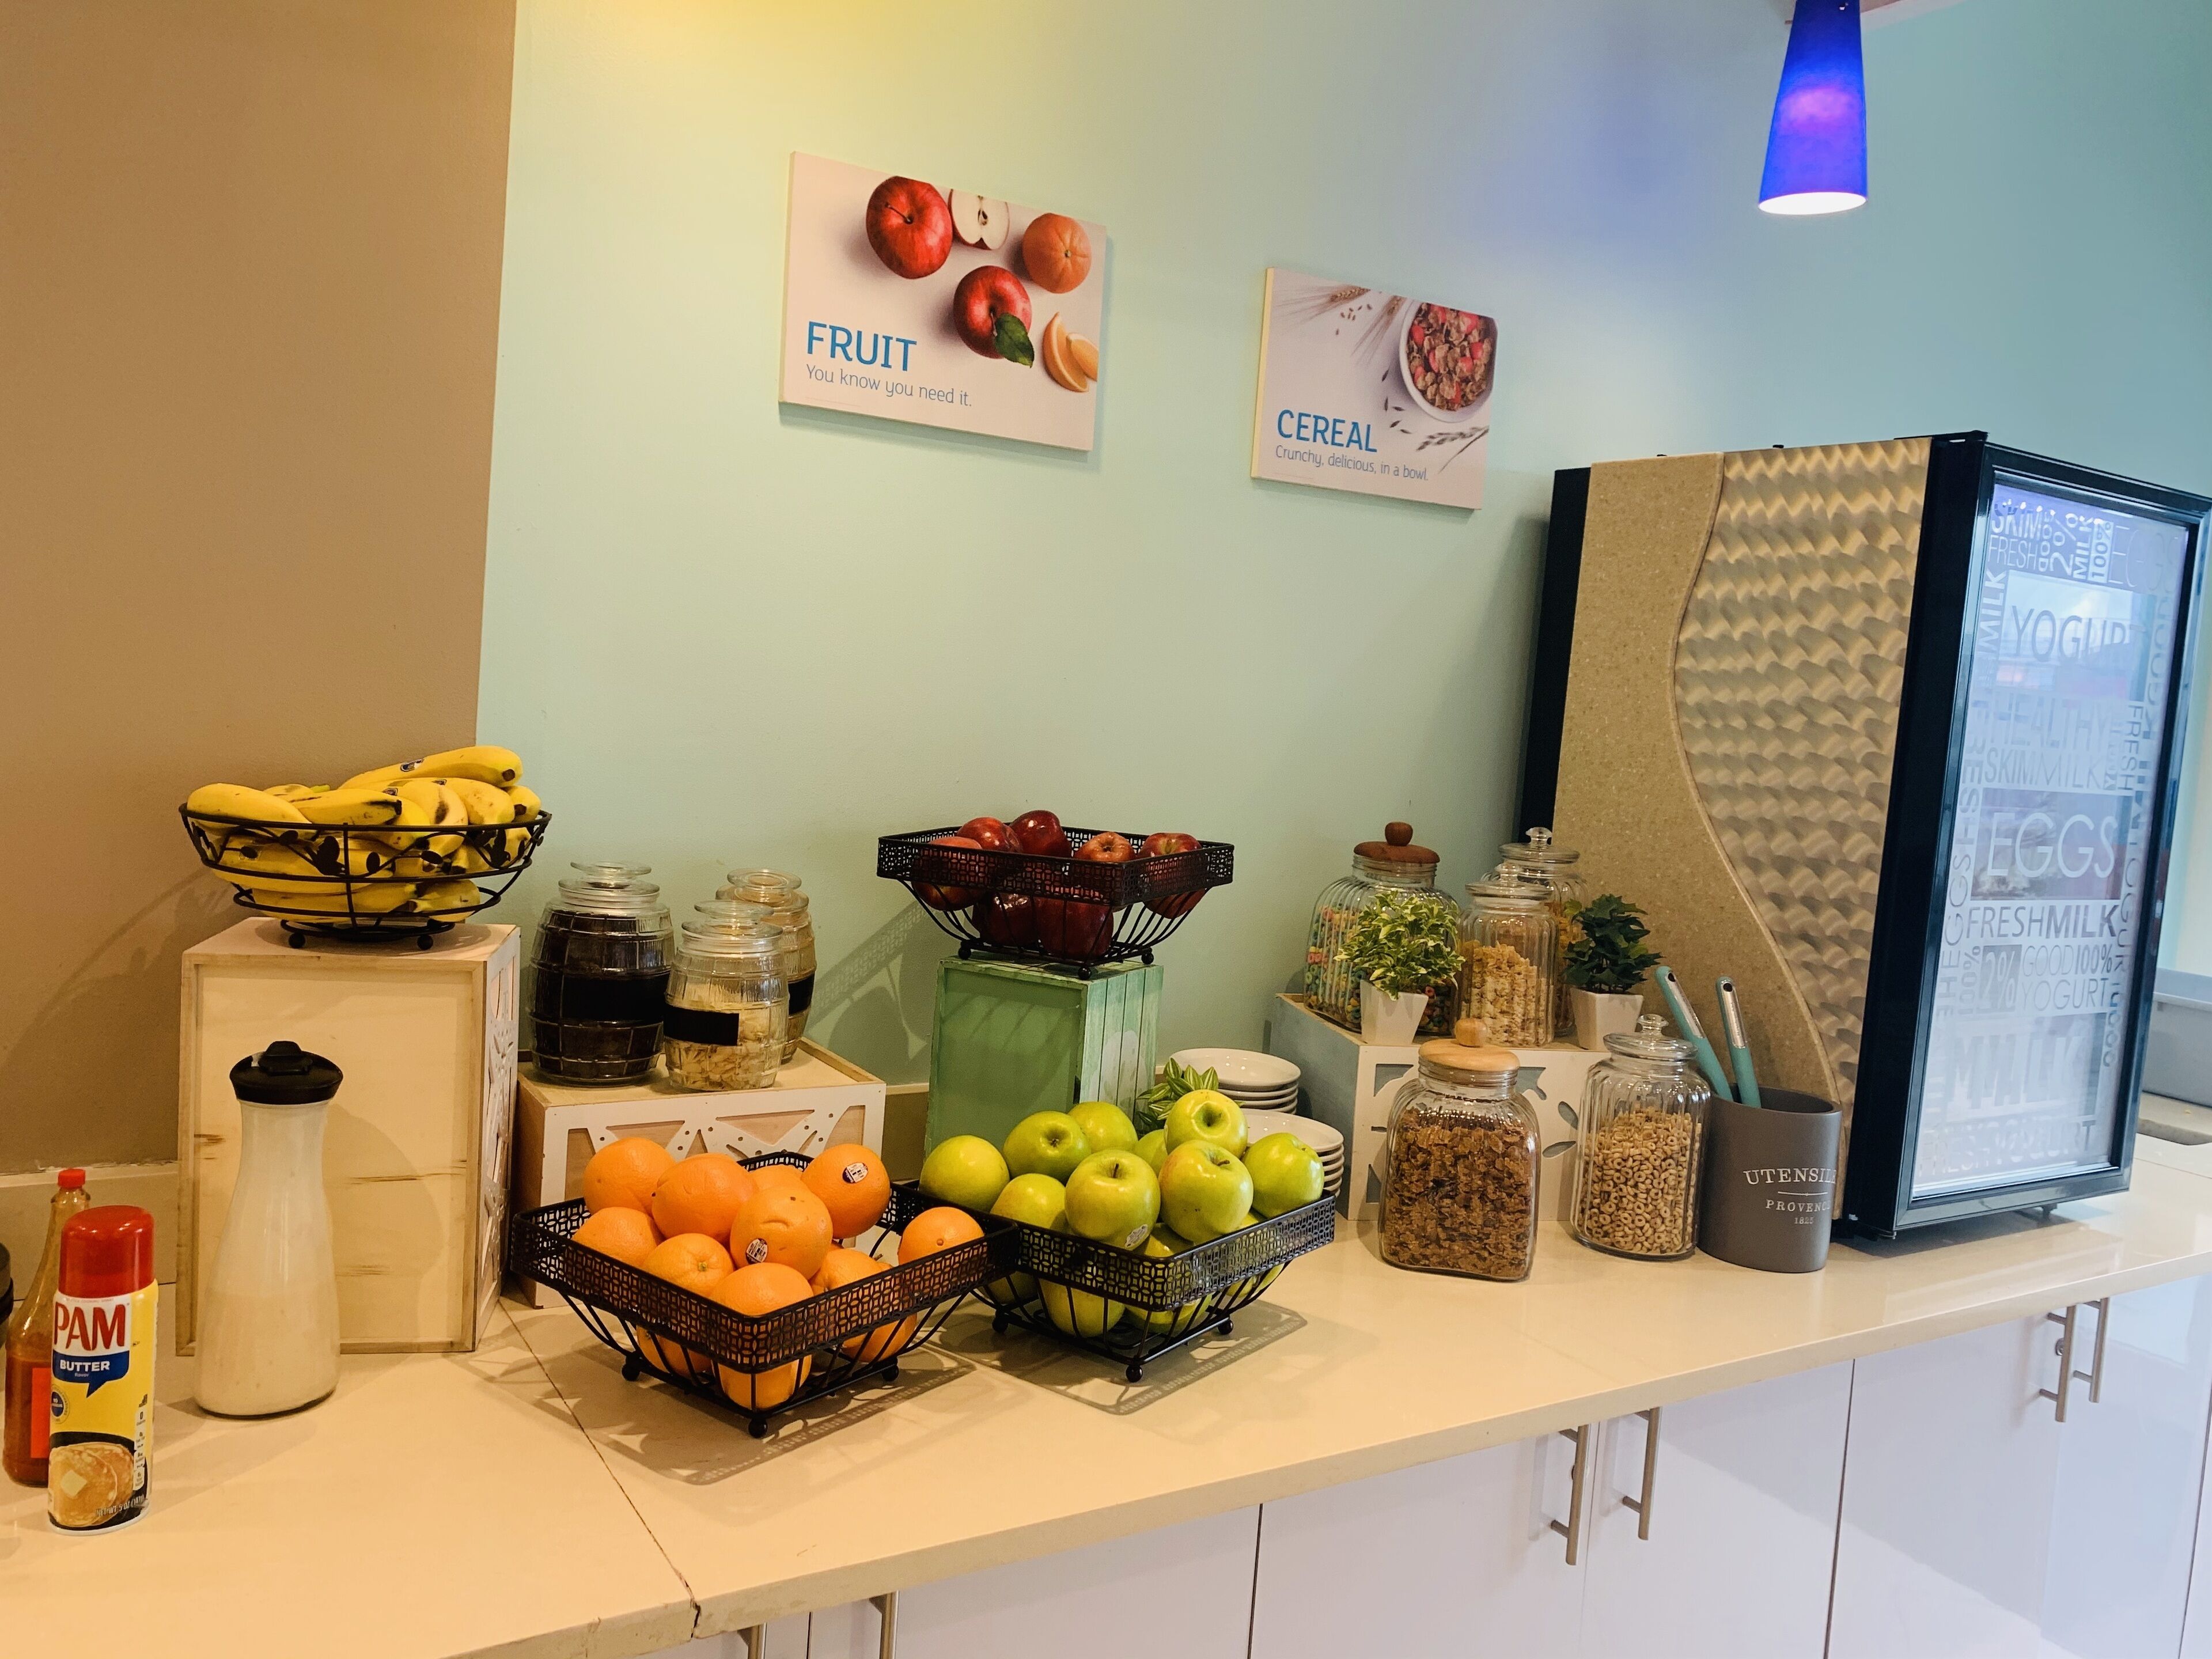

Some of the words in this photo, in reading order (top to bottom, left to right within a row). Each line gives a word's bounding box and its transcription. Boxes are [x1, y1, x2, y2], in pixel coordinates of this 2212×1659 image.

[806, 321, 918, 372] FRUIT
[806, 363, 835, 384] You
[839, 368, 881, 391] know
[885, 378, 914, 397] you
[919, 385, 955, 404] need
[959, 390, 972, 407] it.
[1277, 409, 1377, 453] CEREAL
[1275, 444, 1324, 467] Crunchy,
[1328, 453, 1377, 475] delicious,
[1380, 461, 1390, 474] in
[1393, 465, 1399, 476] a
[1403, 464, 1429, 481] bowl.
[1991, 502, 2041, 541] SKIM
[2038, 510, 2055, 572] GOOD
[2048, 512, 2080, 576] 2%
[2073, 514, 2095, 579] MILK
[1987, 535, 2038, 570] FRESH
[2091, 520, 2112, 579] 100%
[1976, 570, 2008, 653] MILK
[1991, 692, 2107, 751] HEALTHY
[2117, 704, 2144, 791] FRESH
[1986, 812, 2119, 878] EGGS
[1957, 945, 1981, 1015] 100%
[1978, 950, 2016, 1009] 2%
[2021, 978, 2109, 1011] YOGURT
[1766, 1199, 1830, 1213] PROVENC
[54, 1301, 126, 1351] PAM
[59, 1359, 111, 1372] BUTTER
